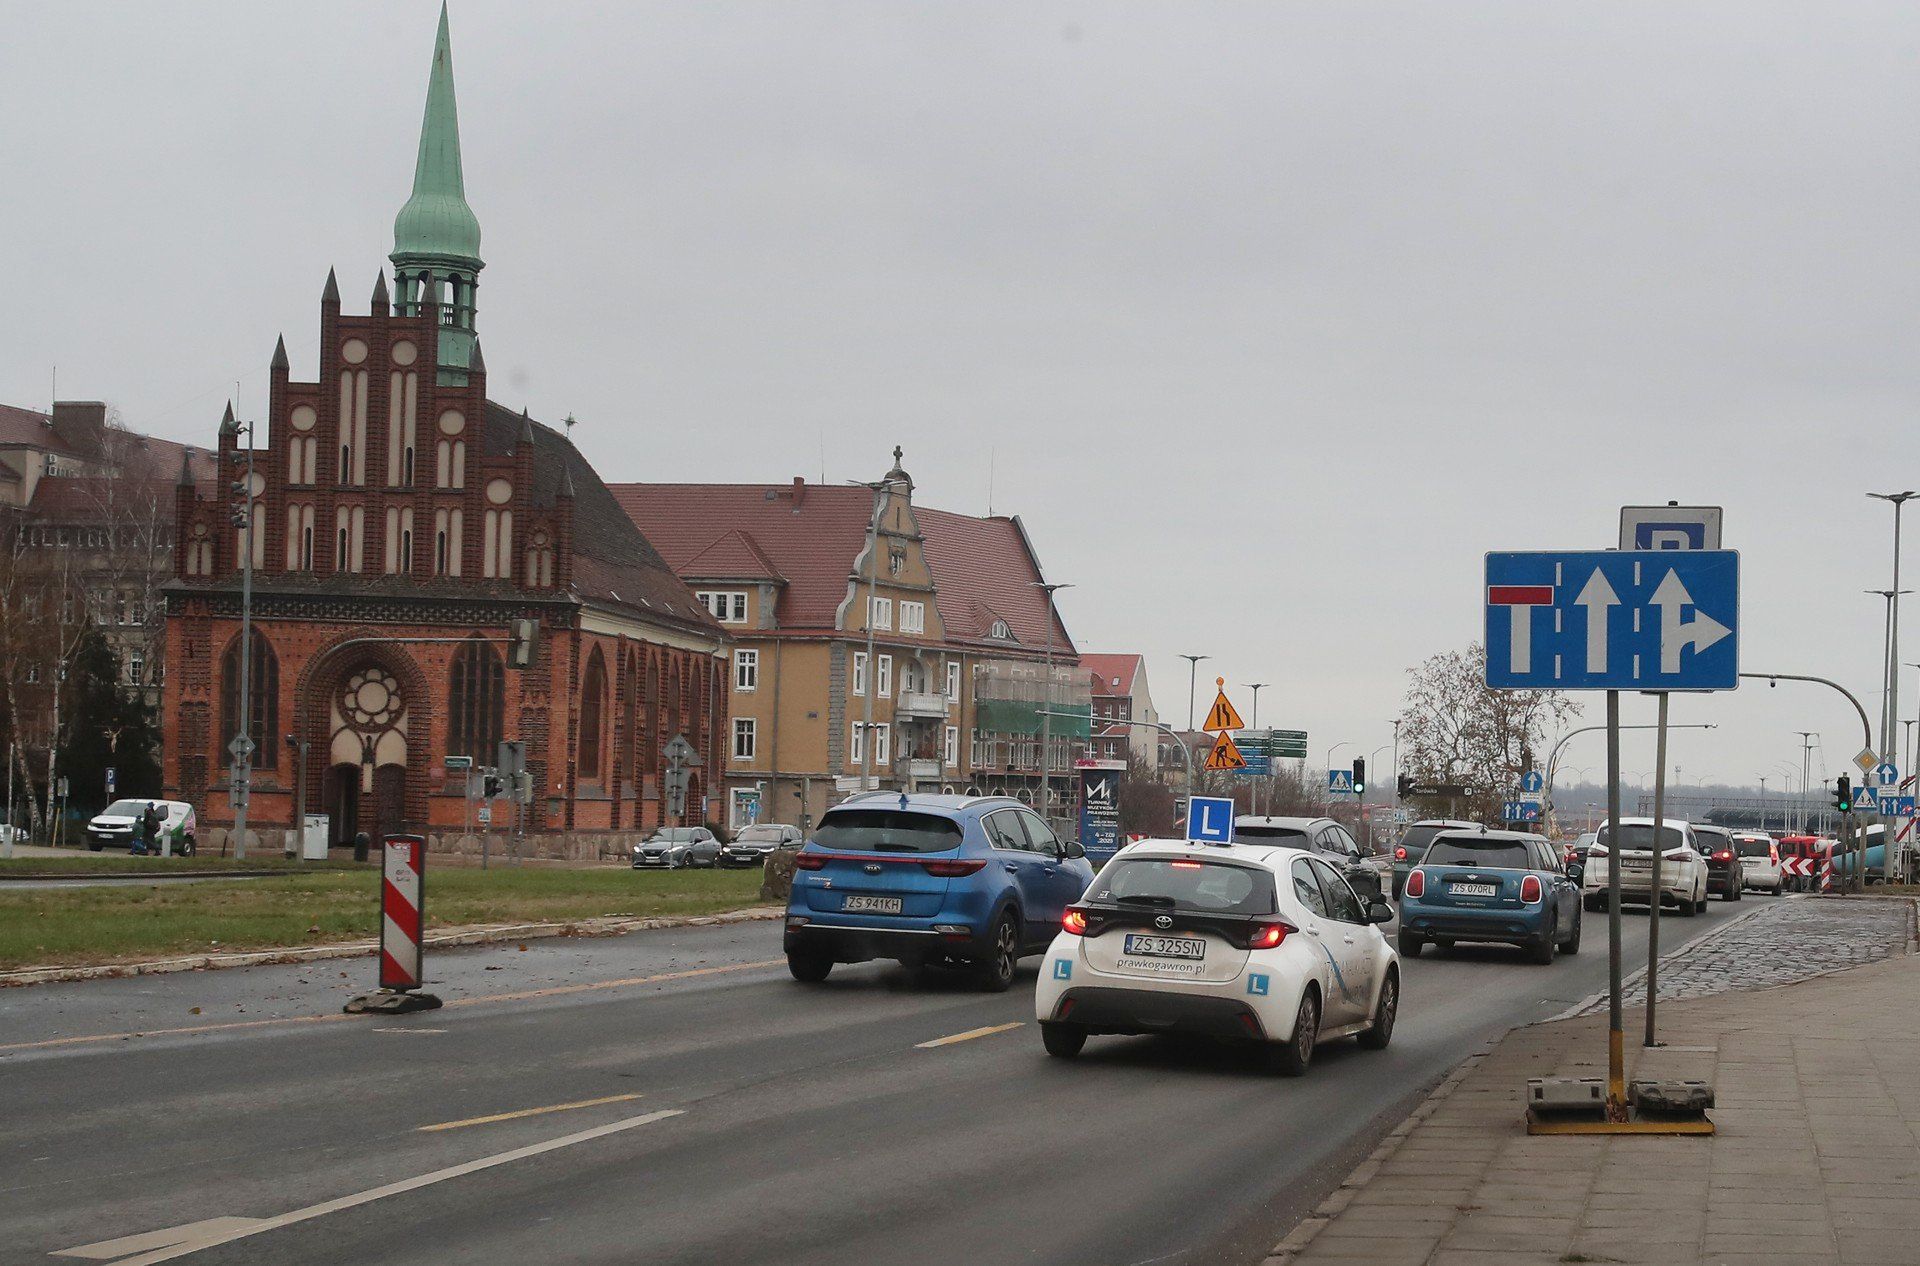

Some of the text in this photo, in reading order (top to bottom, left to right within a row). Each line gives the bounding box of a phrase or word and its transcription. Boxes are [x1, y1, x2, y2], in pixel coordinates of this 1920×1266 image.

[107, 769, 114, 782] P
[1202, 805, 1220, 835] L
[1453, 883, 1465, 893] ZS
[848, 897, 899, 910] ZS 941KH
[1133, 937, 1152, 951] ZS
[1157, 939, 1201, 955] 325SN
[1057, 962, 1067, 978] L
[1116, 957, 1206, 975] prawkogawron.pl
[1251, 976, 1264, 993] L
